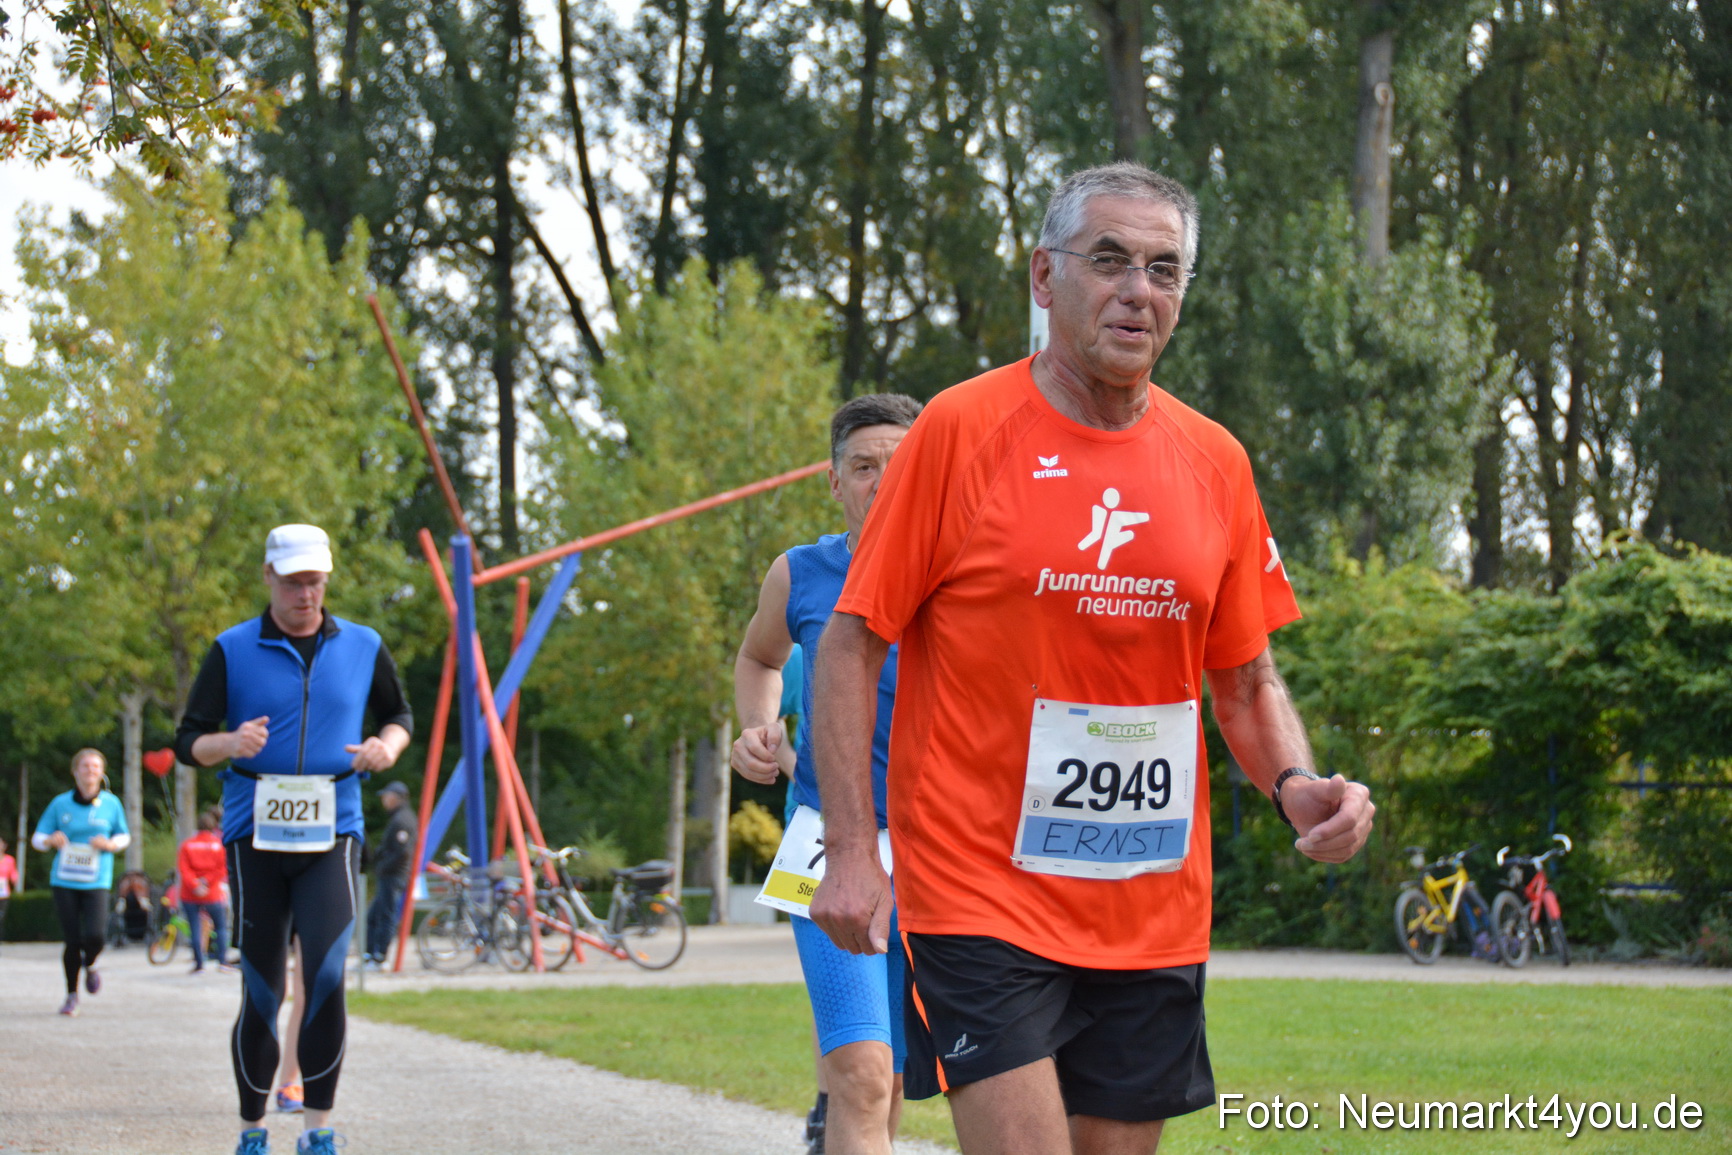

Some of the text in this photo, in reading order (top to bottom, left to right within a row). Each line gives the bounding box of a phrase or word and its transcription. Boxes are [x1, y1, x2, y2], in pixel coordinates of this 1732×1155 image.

[1033, 468, 1068, 479] erima
[1034, 568, 1176, 596] funrunners
[1077, 596, 1191, 621] neumarkt
[1106, 721, 1157, 738] BOCK
[1052, 758, 1171, 812] 2949
[267, 799, 320, 821] 2021
[1042, 822, 1174, 856] ERNST
